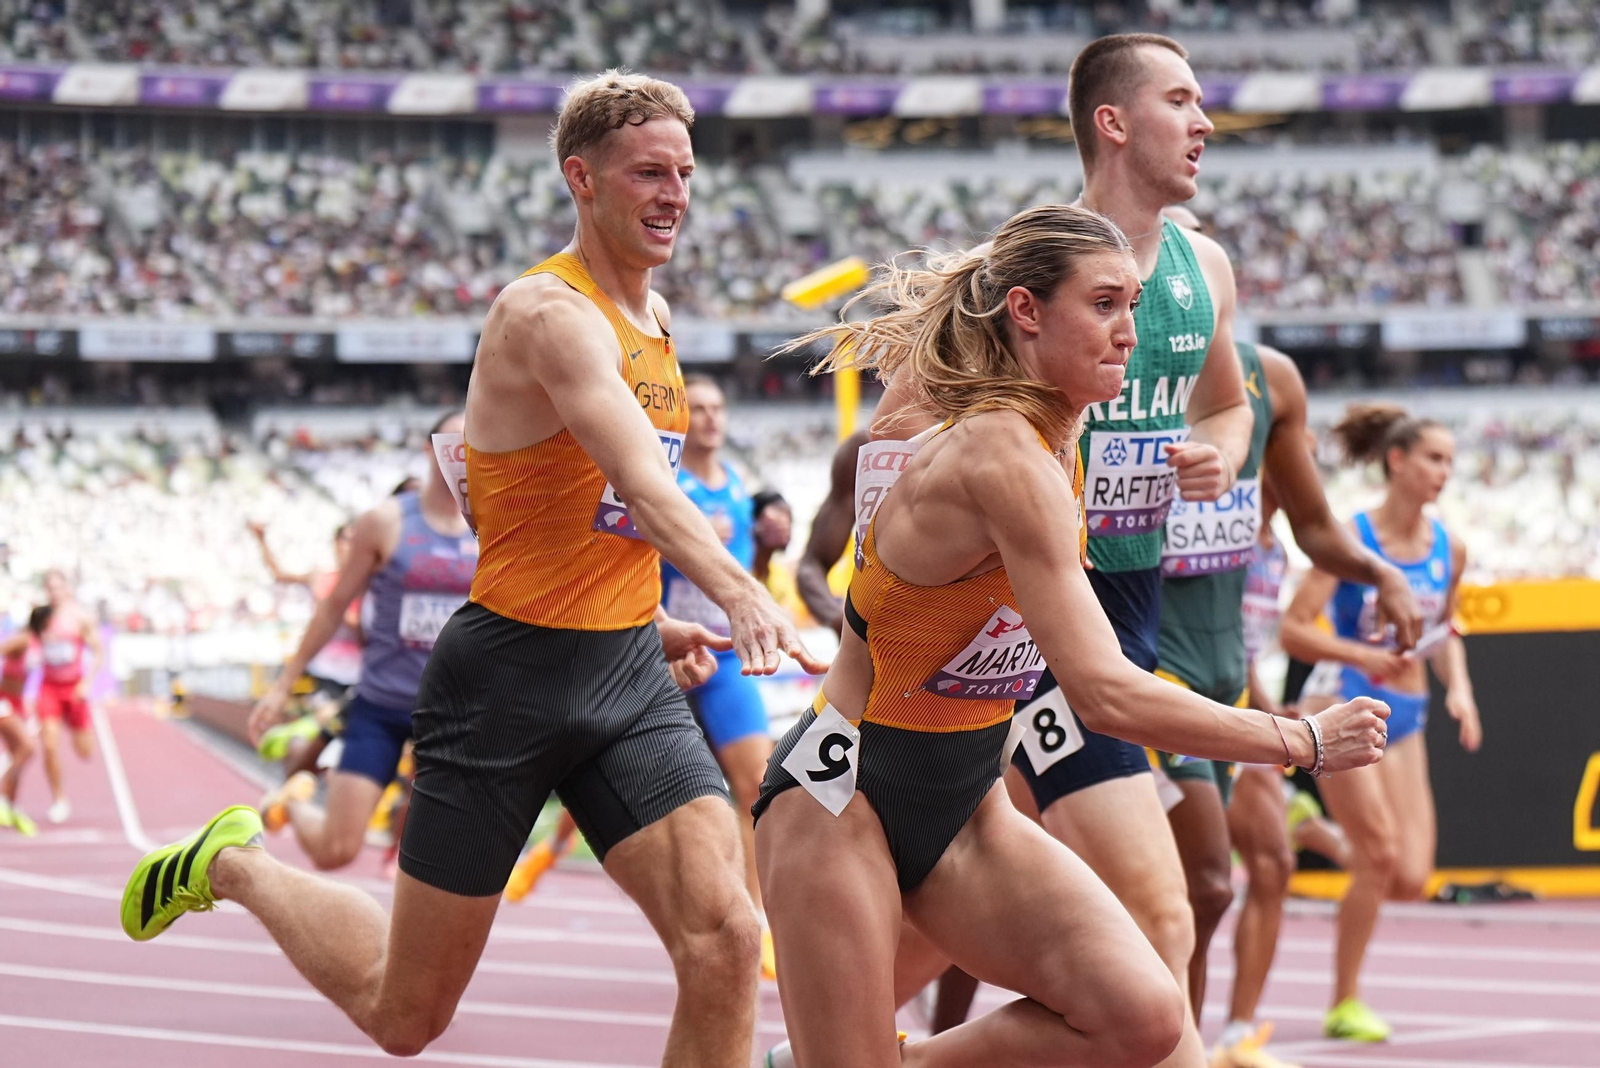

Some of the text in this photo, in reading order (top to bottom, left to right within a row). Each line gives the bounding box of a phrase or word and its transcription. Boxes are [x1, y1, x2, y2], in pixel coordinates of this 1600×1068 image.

[1169, 333, 1205, 353] 123.ie
[1129, 435, 1190, 466] TD
[964, 678, 1024, 695] TOKYO
[1033, 708, 1067, 753] 8
